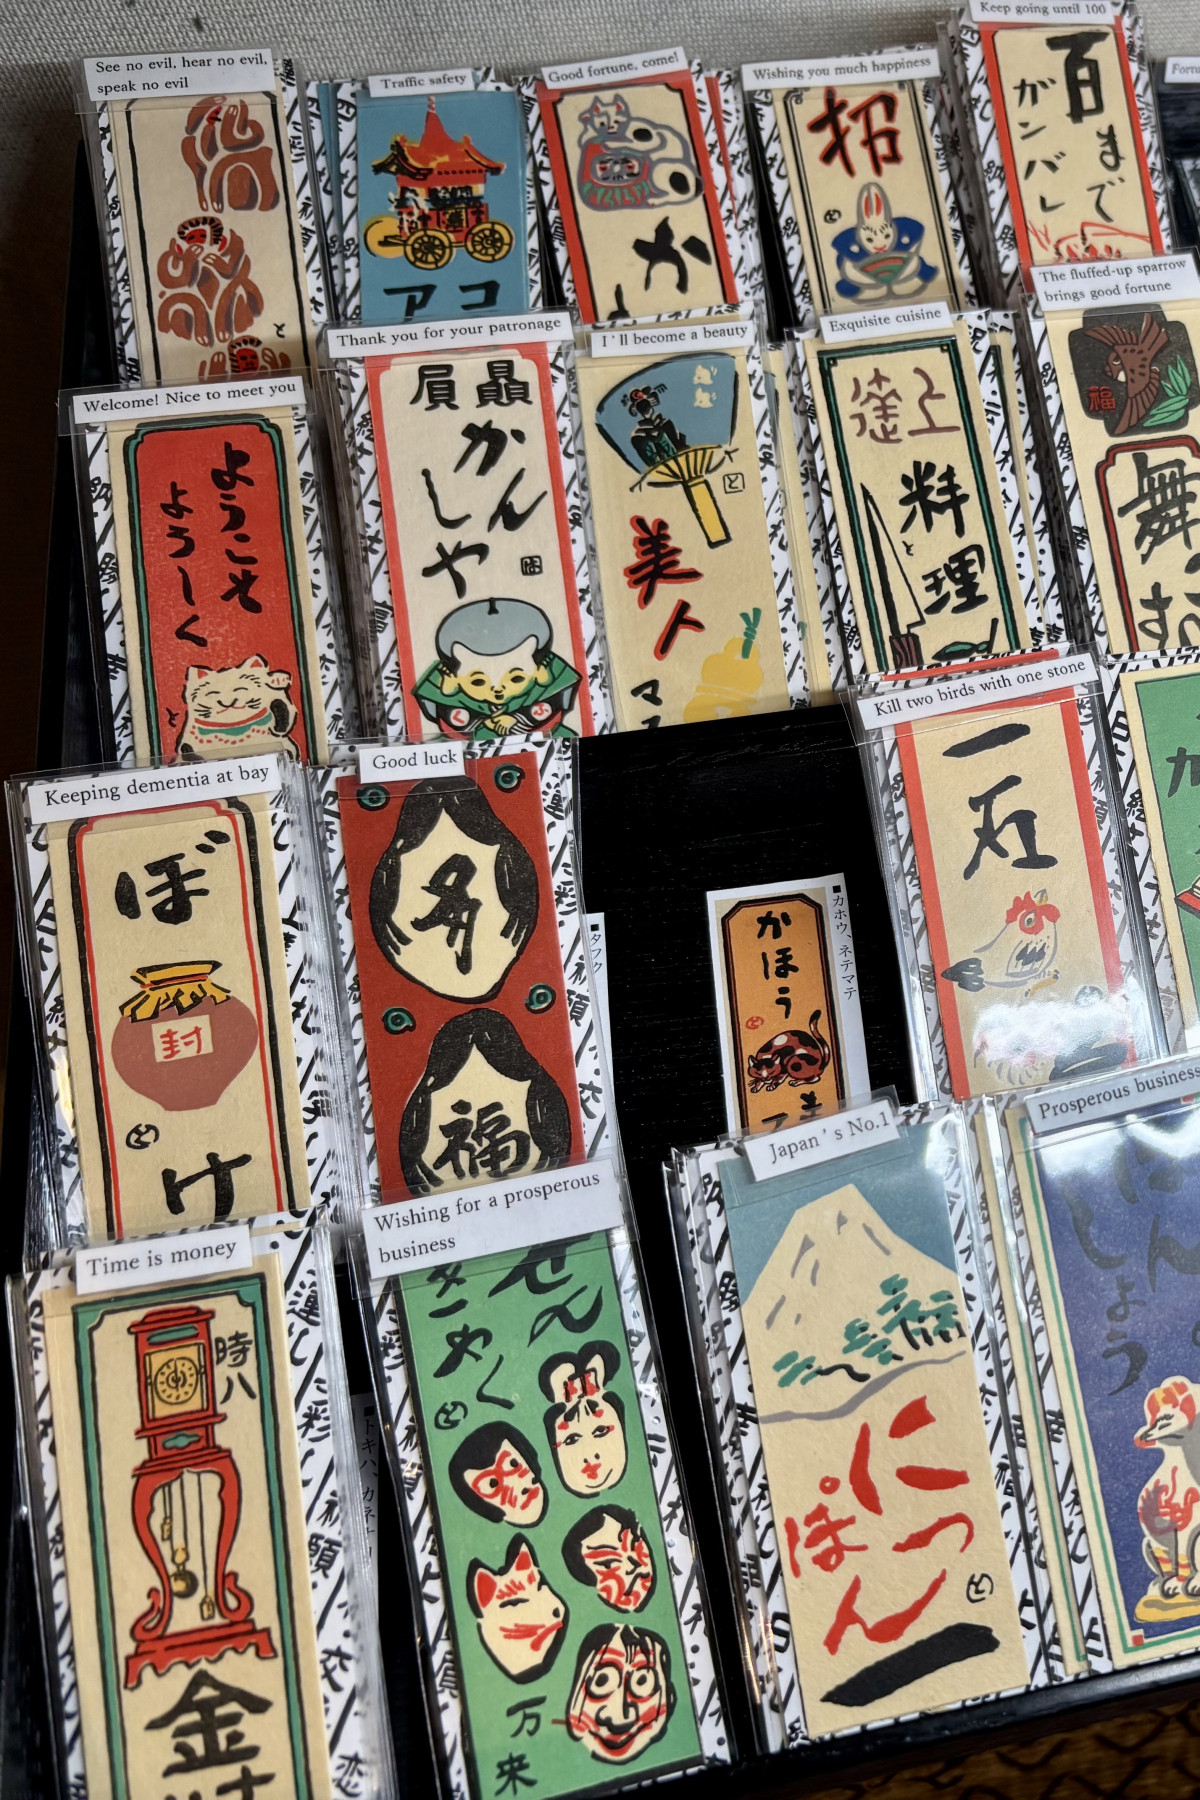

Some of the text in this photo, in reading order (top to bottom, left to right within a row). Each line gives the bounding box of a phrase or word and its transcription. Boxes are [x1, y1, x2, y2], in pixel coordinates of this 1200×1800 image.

[979, 1, 1107, 17] Keep going until 100
[95, 52, 268, 73] See no evil, hear no evil,
[549, 51, 679, 85] Good fortune, come!
[752, 57, 932, 81] Wishing you much happiness
[97, 76, 189, 96] speak no evil
[380, 73, 467, 89] Traffic safety
[809, 87, 903, 178] 招
[1046, 31, 1126, 222] 百まで
[1014, 78, 1065, 213] ガンバレ
[1038, 260, 1186, 283] The fluffed-up sparrow
[1043, 282, 1172, 302] brings good fortune
[336, 319, 561, 347] Thank you for your patronage
[633, 332, 686, 345] become
[690, 331, 698, 340] a
[702, 326, 748, 339] beauty
[828, 308, 941, 333] Exquisite cuisine
[82, 383, 296, 413] Welcome! Nice to meet you
[212, 442, 263, 613] ようこそ
[900, 461, 987, 616] 料理
[624, 514, 706, 660] 美人
[873, 661, 1086, 717] Kill two birds with one stone
[372, 749, 458, 770] Good luck
[44, 764, 269, 807] Keeping dementia at bay
[941, 722, 1059, 881] 一石
[1038, 1085, 1131, 1120] Prosperous
[848, 1111, 890, 1138] No.1
[373, 1174, 600, 1232] Wishing for a prosperous
[86, 1242, 237, 1277] Time is money
[378, 1237, 456, 1263] business
